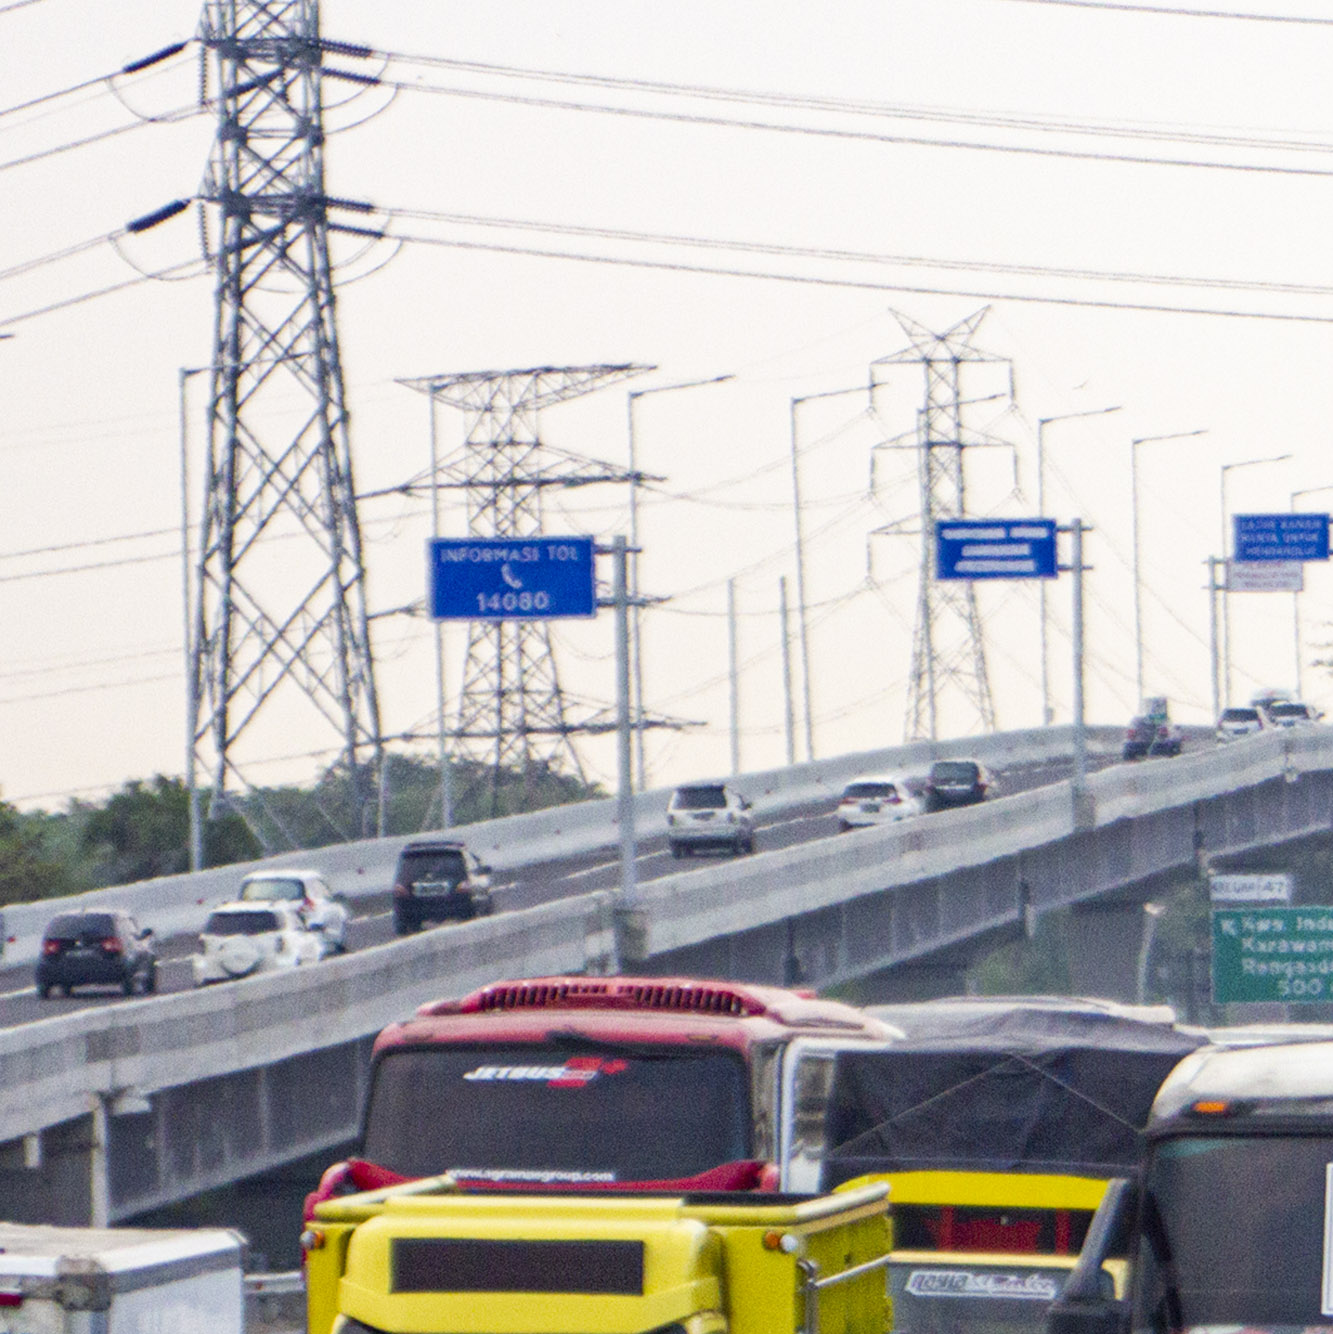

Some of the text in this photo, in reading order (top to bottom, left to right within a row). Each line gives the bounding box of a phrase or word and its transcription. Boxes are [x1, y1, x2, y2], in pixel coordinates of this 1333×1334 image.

[440, 545, 578, 562] INFORMASI TOL
[476, 591, 550, 612] 14080
[1279, 979, 1322, 995] 500
